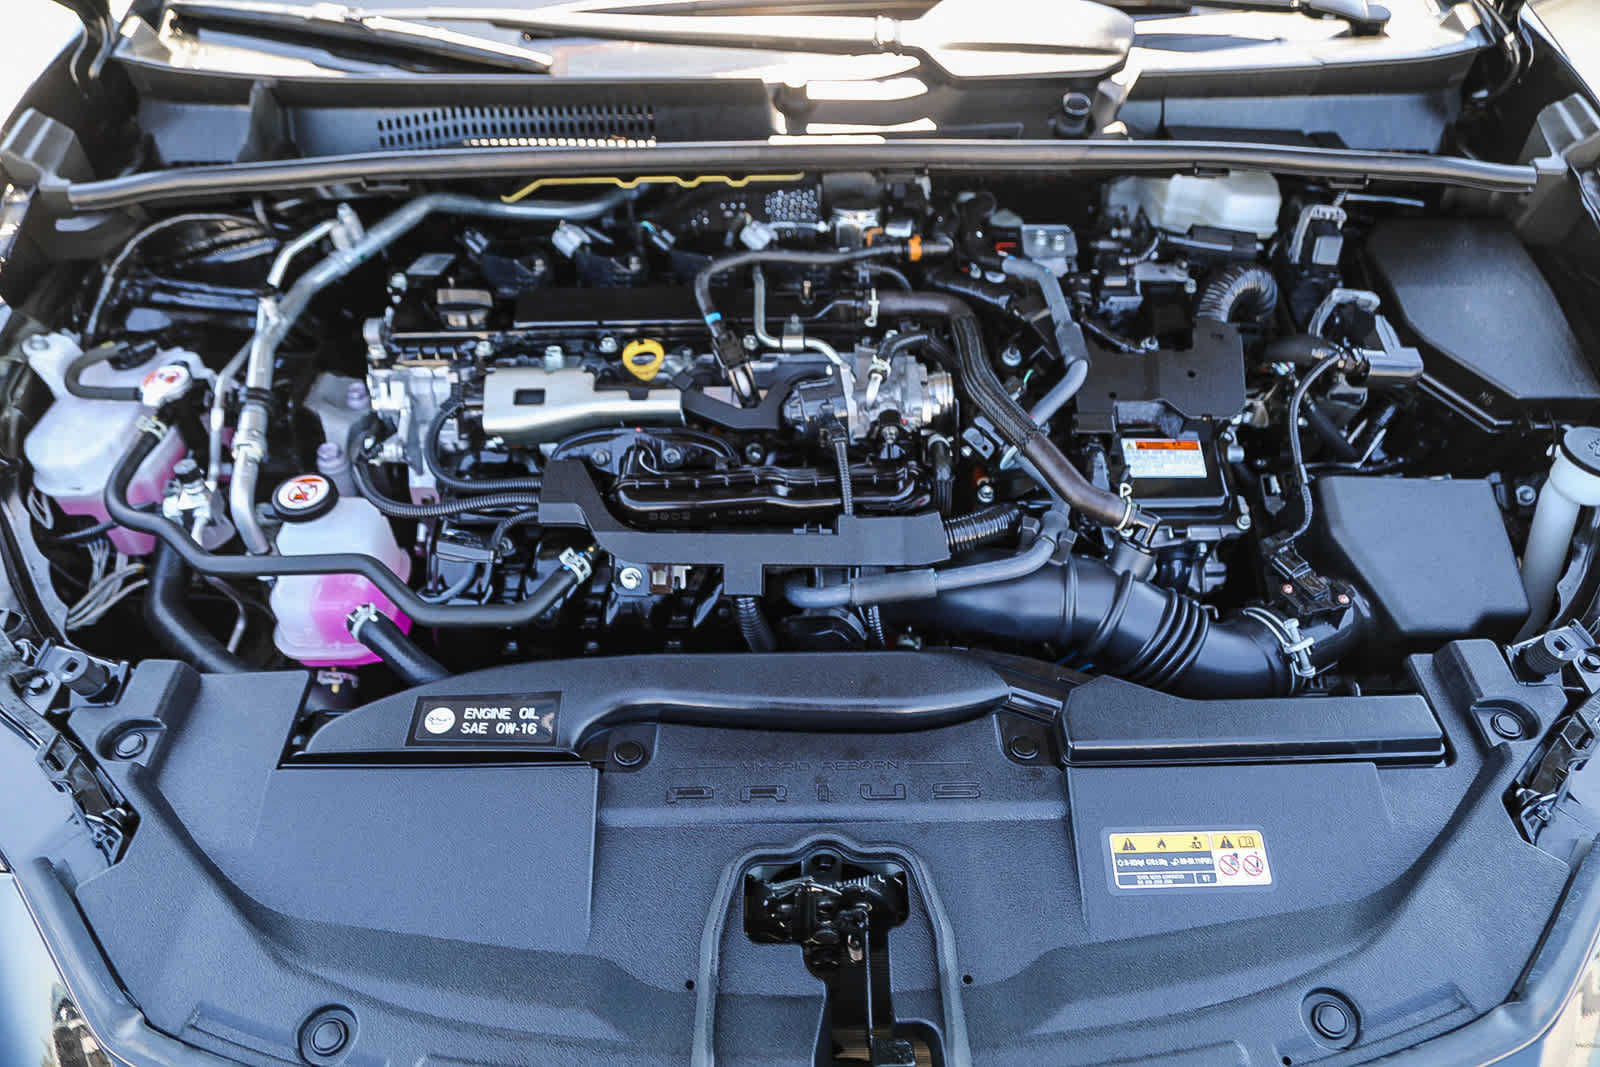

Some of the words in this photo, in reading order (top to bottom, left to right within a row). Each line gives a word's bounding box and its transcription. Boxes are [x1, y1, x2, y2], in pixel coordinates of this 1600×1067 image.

[463, 707, 512, 720] ENGINE
[519, 707, 540, 720] OIL
[460, 722, 489, 734] SAE
[495, 722, 538, 735] 0W-16
[665, 782, 981, 803] PRIUS
